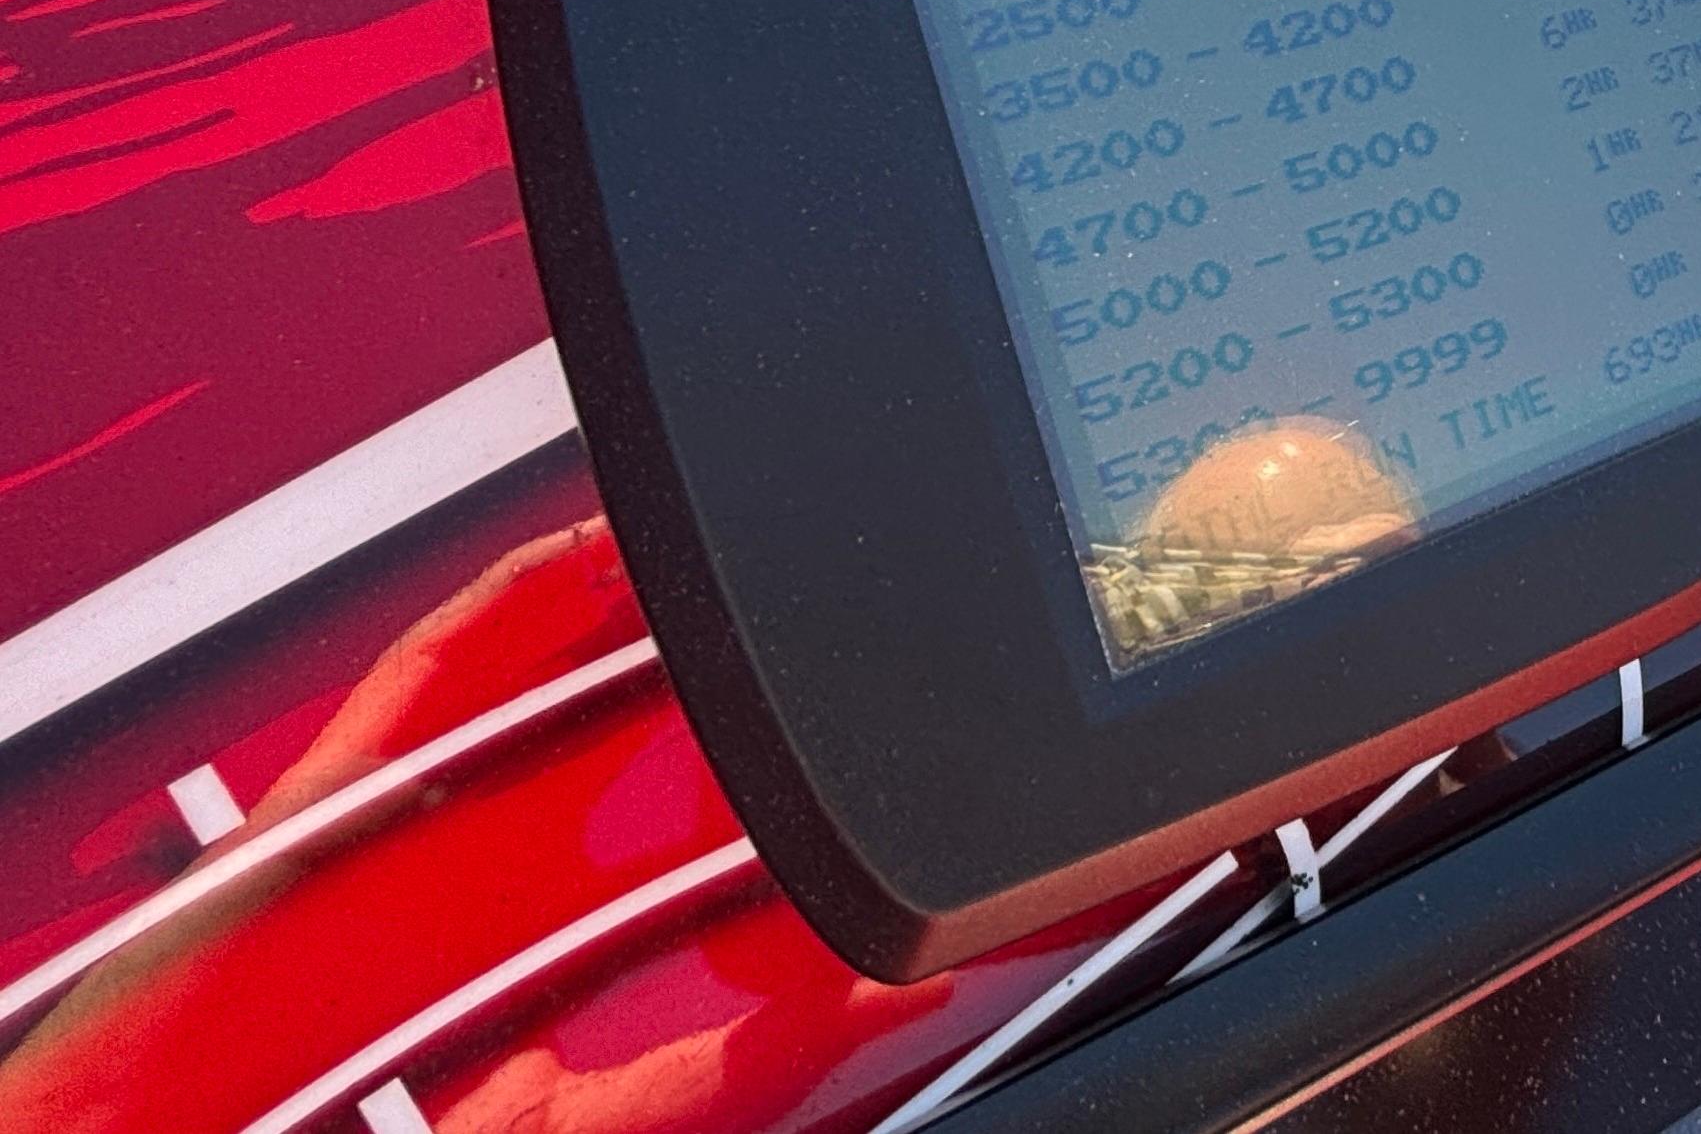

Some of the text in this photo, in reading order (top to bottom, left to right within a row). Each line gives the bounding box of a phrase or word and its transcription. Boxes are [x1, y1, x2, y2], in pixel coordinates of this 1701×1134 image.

[984, 48, 1163, 124] 3500
[1011, 118, 1186, 194] 4200
[1266, 55, 1417, 124] 4700
[1540, 7, 1598, 49] 6HR
[1033, 187, 1209, 267] 4700
[1283, 120, 1440, 195] 5000
[1561, 66, 1621, 112] 2HR
[1051, 258, 1232, 346] 5000
[1306, 186, 1462, 264] 5200
[1587, 128, 1642, 172] 1HR
[1075, 332, 1255, 424] 5200
[1329, 251, 1485, 334] 5300
[1354, 316, 1508, 404] 9999
[1440, 374, 1556, 451] TIME
